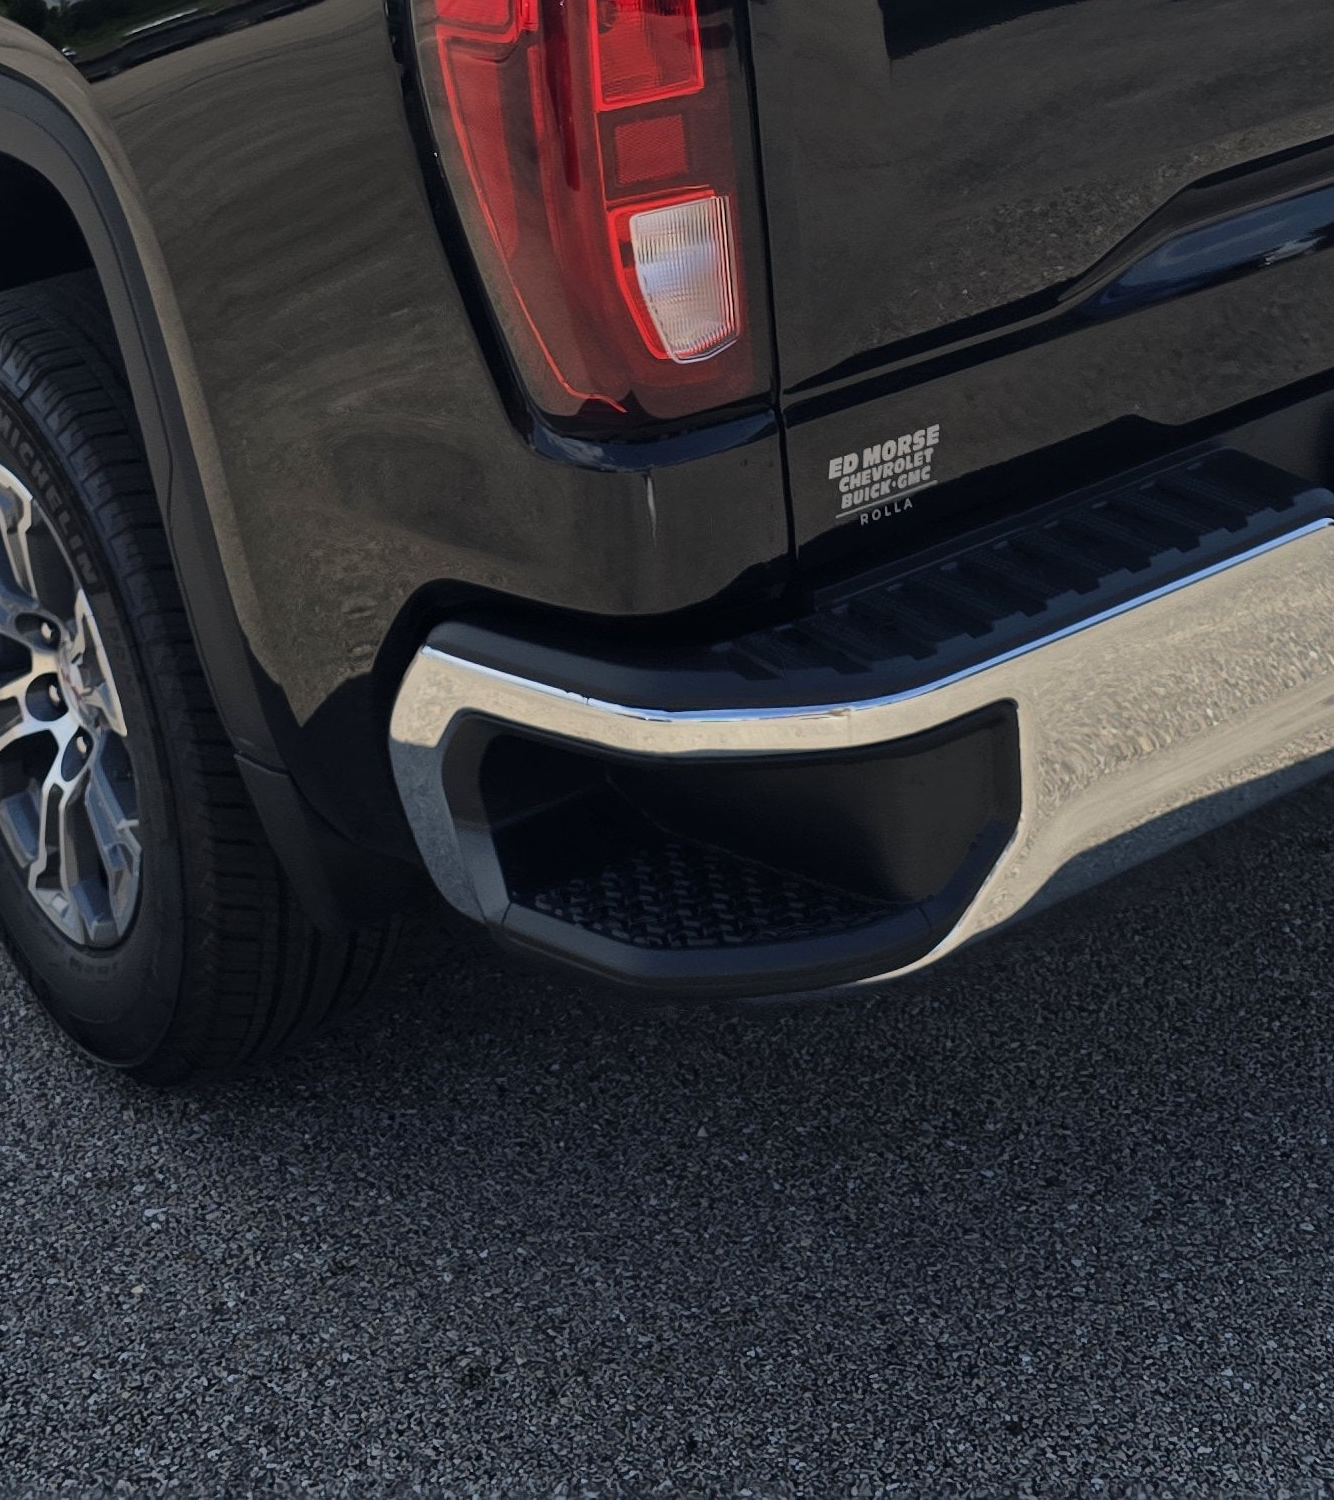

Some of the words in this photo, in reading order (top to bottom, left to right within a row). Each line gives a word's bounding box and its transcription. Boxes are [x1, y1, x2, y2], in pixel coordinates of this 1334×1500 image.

[828, 452, 860, 480] ED
[862, 423, 940, 469] MORSE
[838, 447, 935, 493] CHEVROLET
[860, 498, 914, 526] ROLLA
